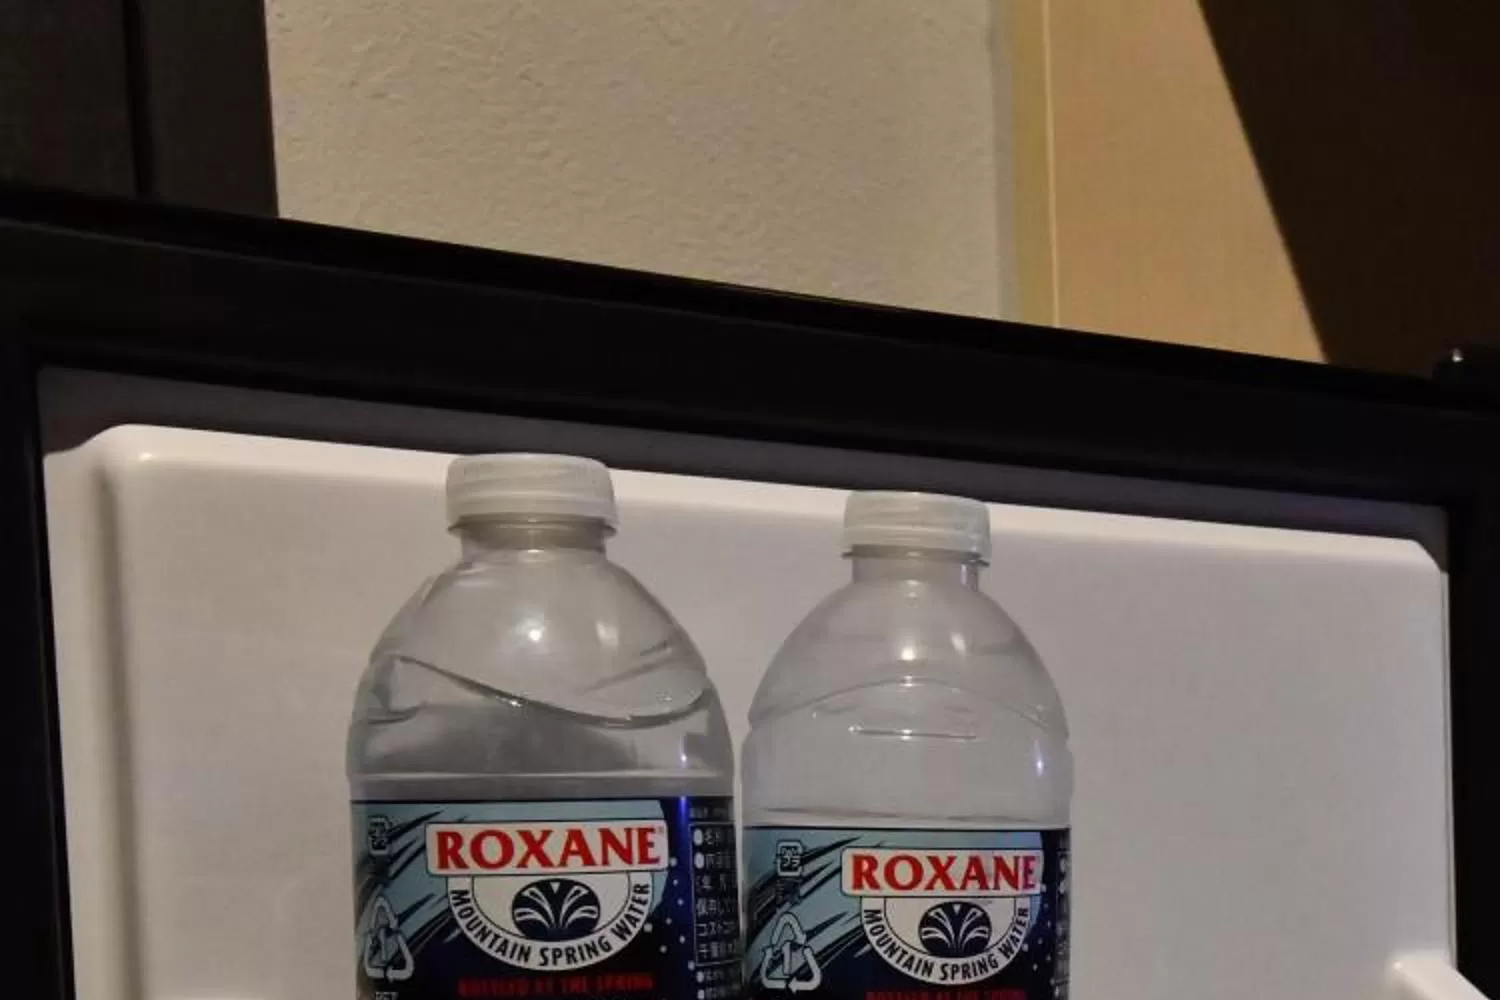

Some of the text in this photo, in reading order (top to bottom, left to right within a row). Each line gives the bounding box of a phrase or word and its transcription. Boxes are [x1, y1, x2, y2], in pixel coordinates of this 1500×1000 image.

[435, 827, 661, 869] ROXANE
[851, 855, 1037, 891] ROXANE
[450, 882, 651, 966] MOUNTAIN SPRING WATER
[863, 907, 1029, 981] MOUNTAIN SPRING WATER
